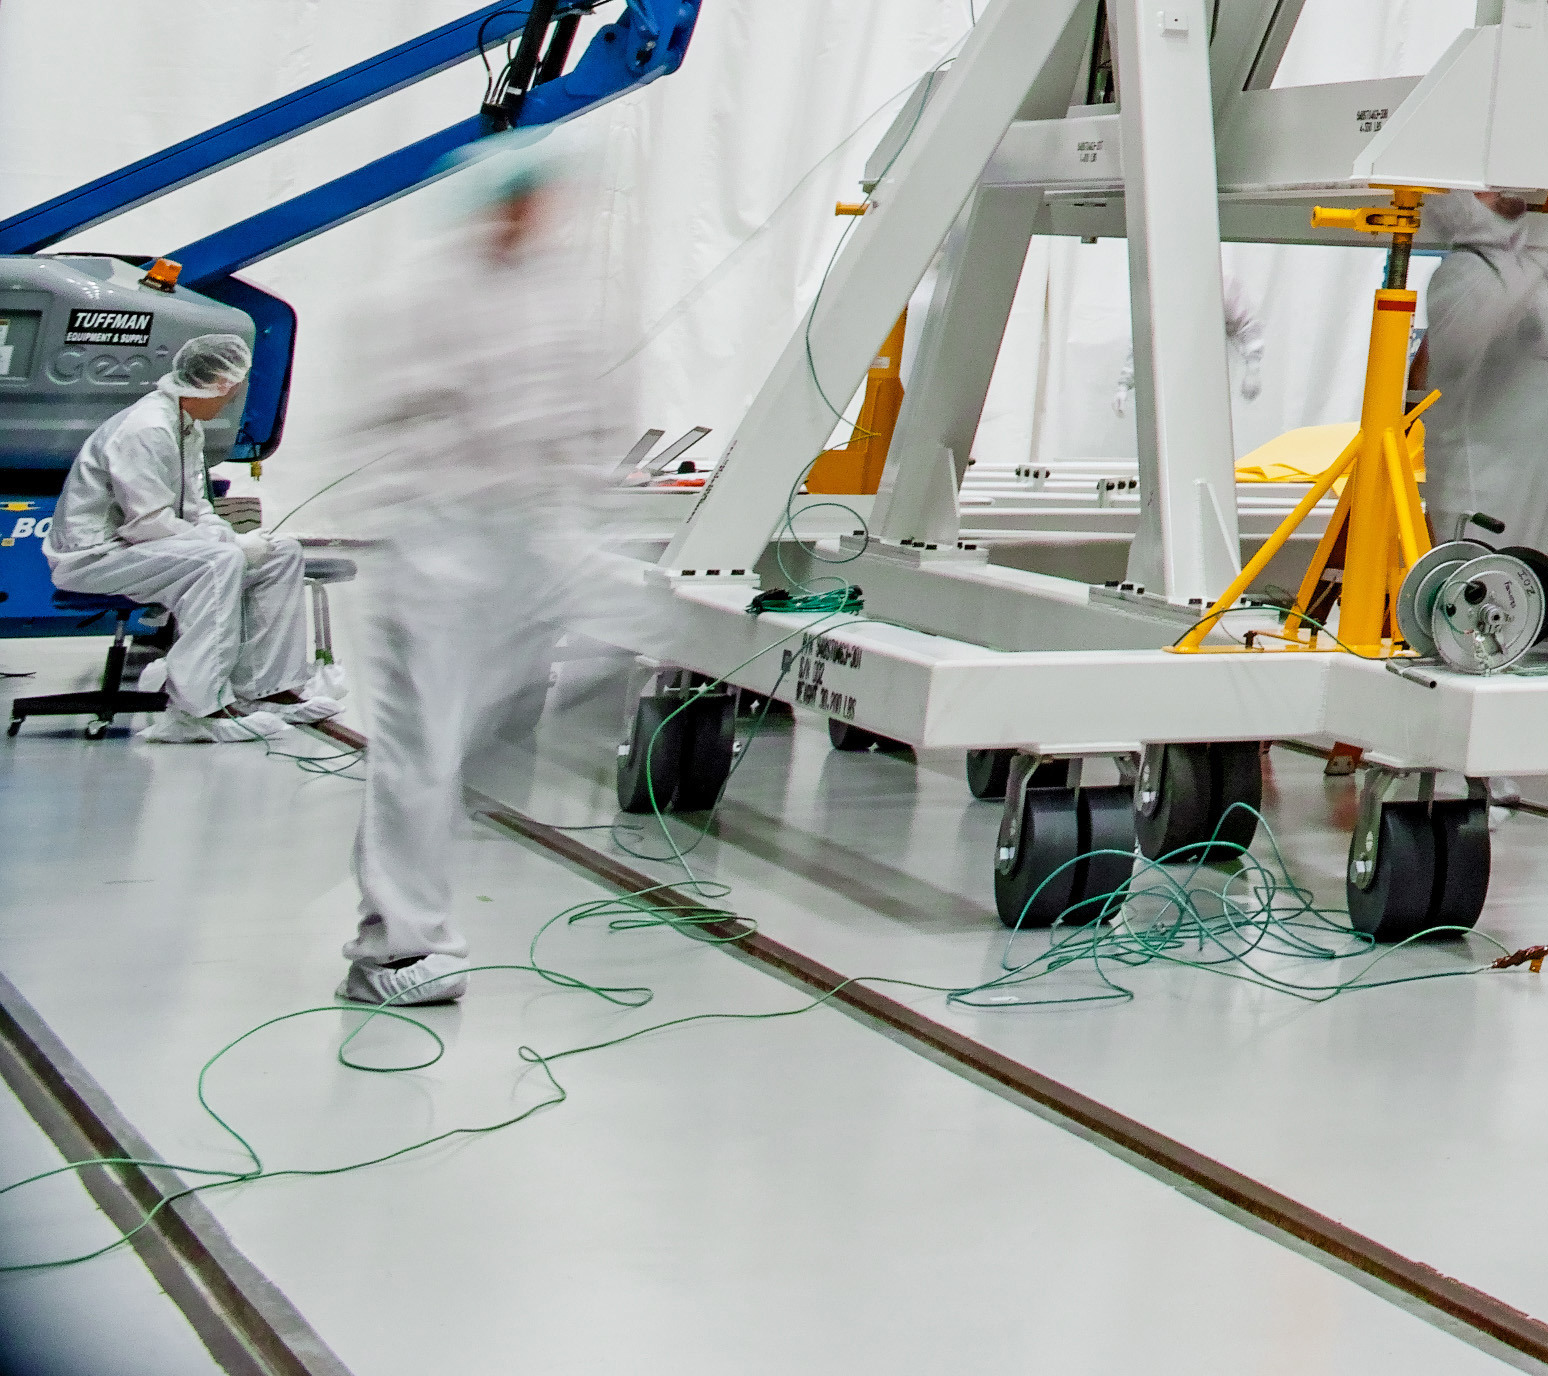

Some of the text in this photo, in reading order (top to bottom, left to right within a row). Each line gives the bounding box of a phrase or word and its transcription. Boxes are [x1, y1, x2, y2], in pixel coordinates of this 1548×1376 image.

[74, 312, 151, 330] TUFFMAN
[66, 331, 149, 344] EQUIPMENT & SUPPLY
